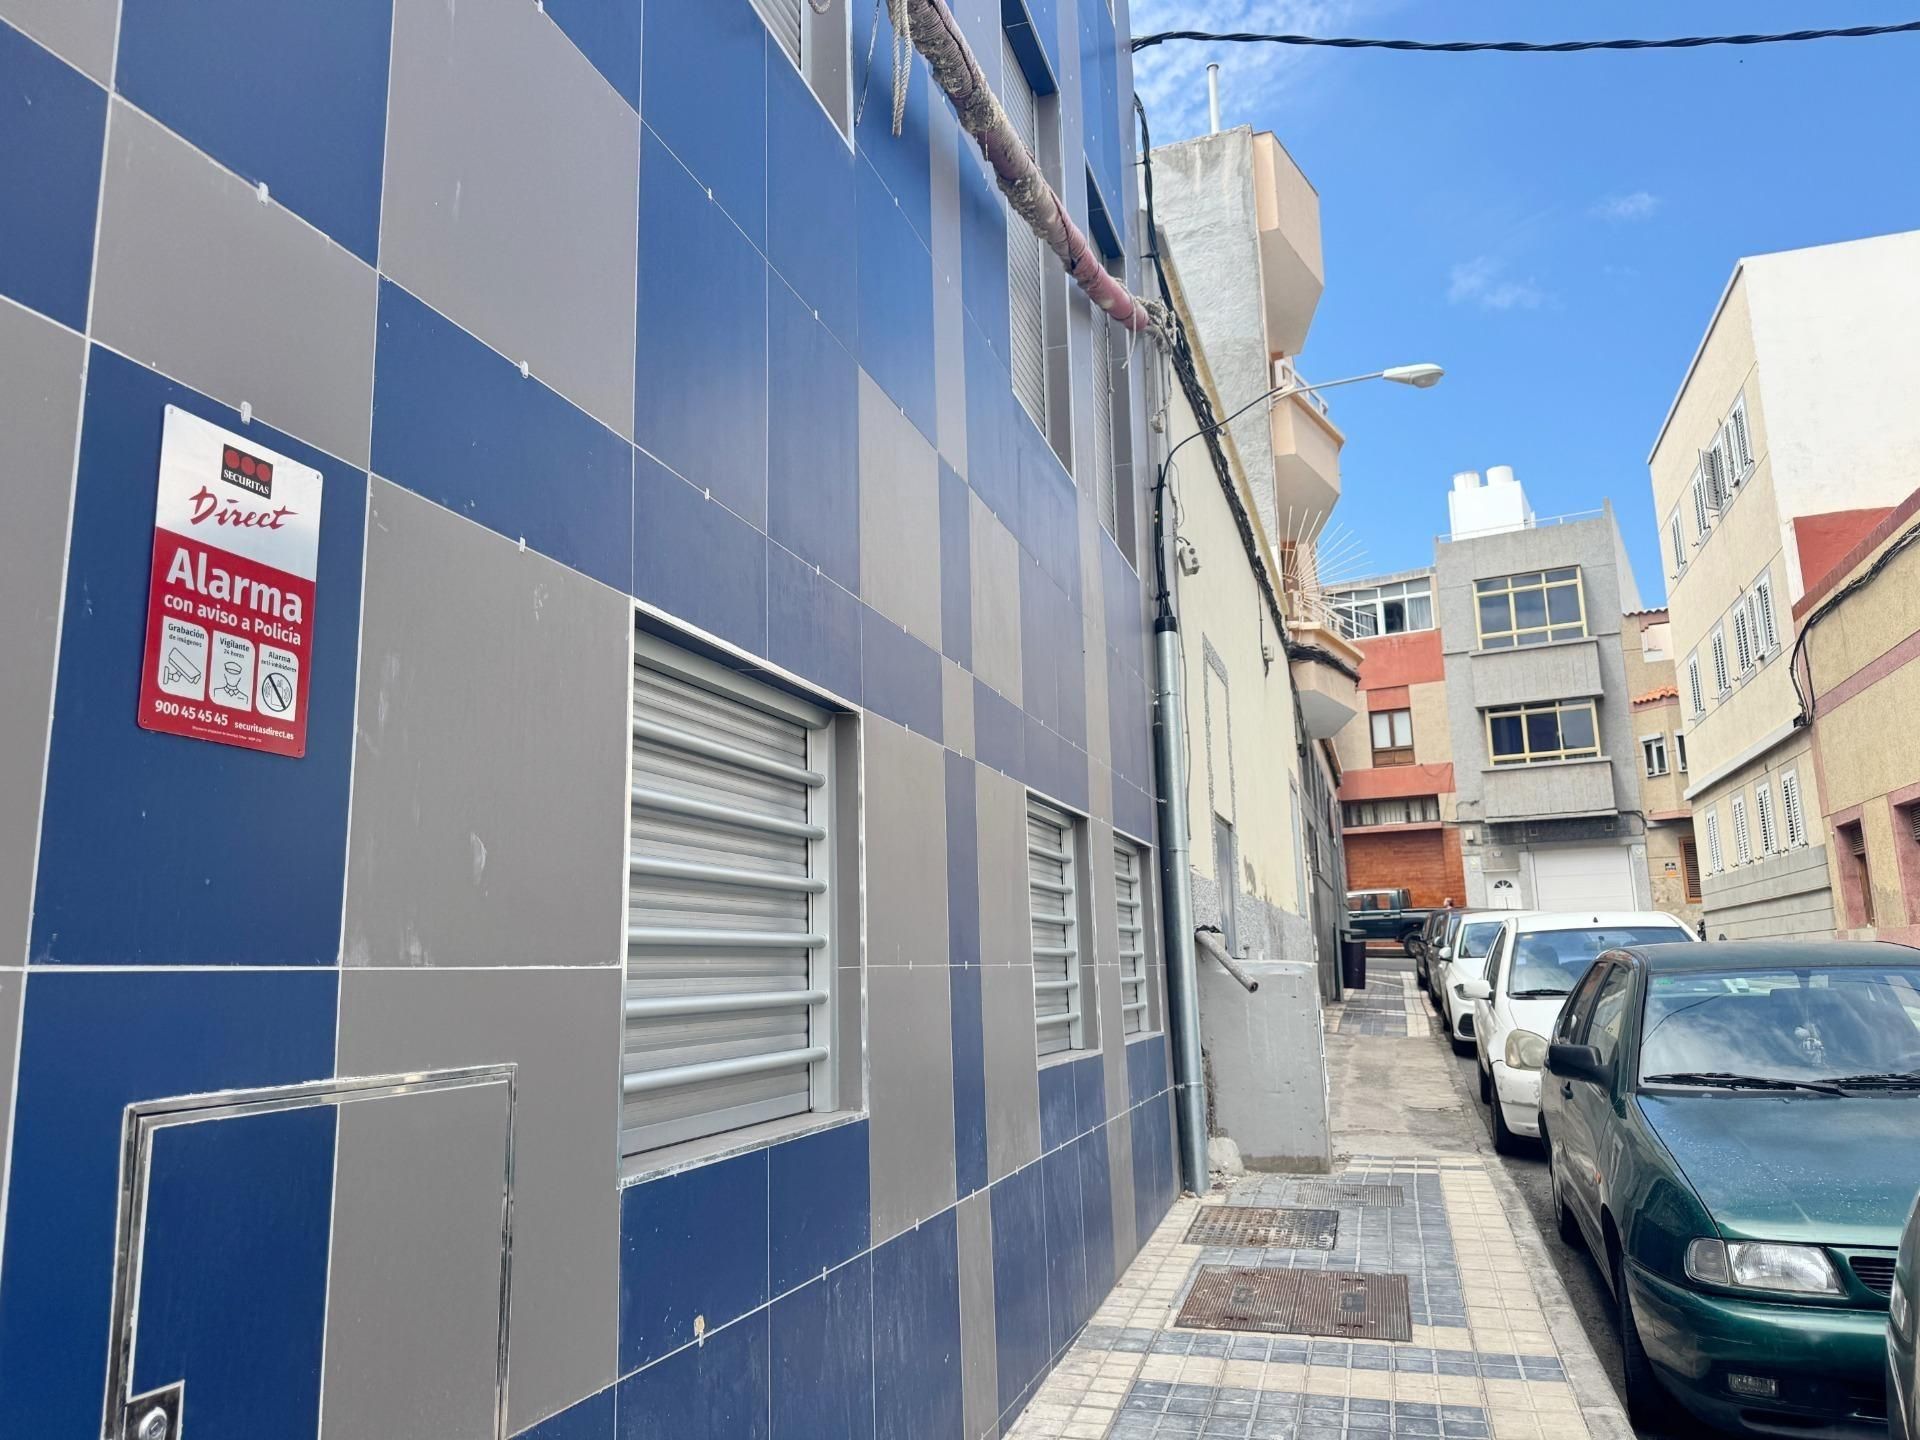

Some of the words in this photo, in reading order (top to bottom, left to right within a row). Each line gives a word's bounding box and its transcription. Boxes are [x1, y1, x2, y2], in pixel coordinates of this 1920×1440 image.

[223, 469, 270, 495] SECURITAS
[189, 485, 299, 530] Direct
[166, 547, 302, 625] Alarma
[164, 594, 193, 614] con
[197, 603, 238, 627] aviso
[241, 617, 250, 631] a
[254, 618, 301, 646] Policía
[168, 623, 205, 640] Grabación
[168, 633, 176, 641] de
[219, 636, 250, 652] Vigilante
[268, 651, 291, 663] Alarma
[155, 700, 179, 716] 900
[180, 705, 196, 720] 45
[197, 709, 212, 723] 45
[213, 713, 229, 726] 45
[234, 721, 294, 741] securitasdirect.es
